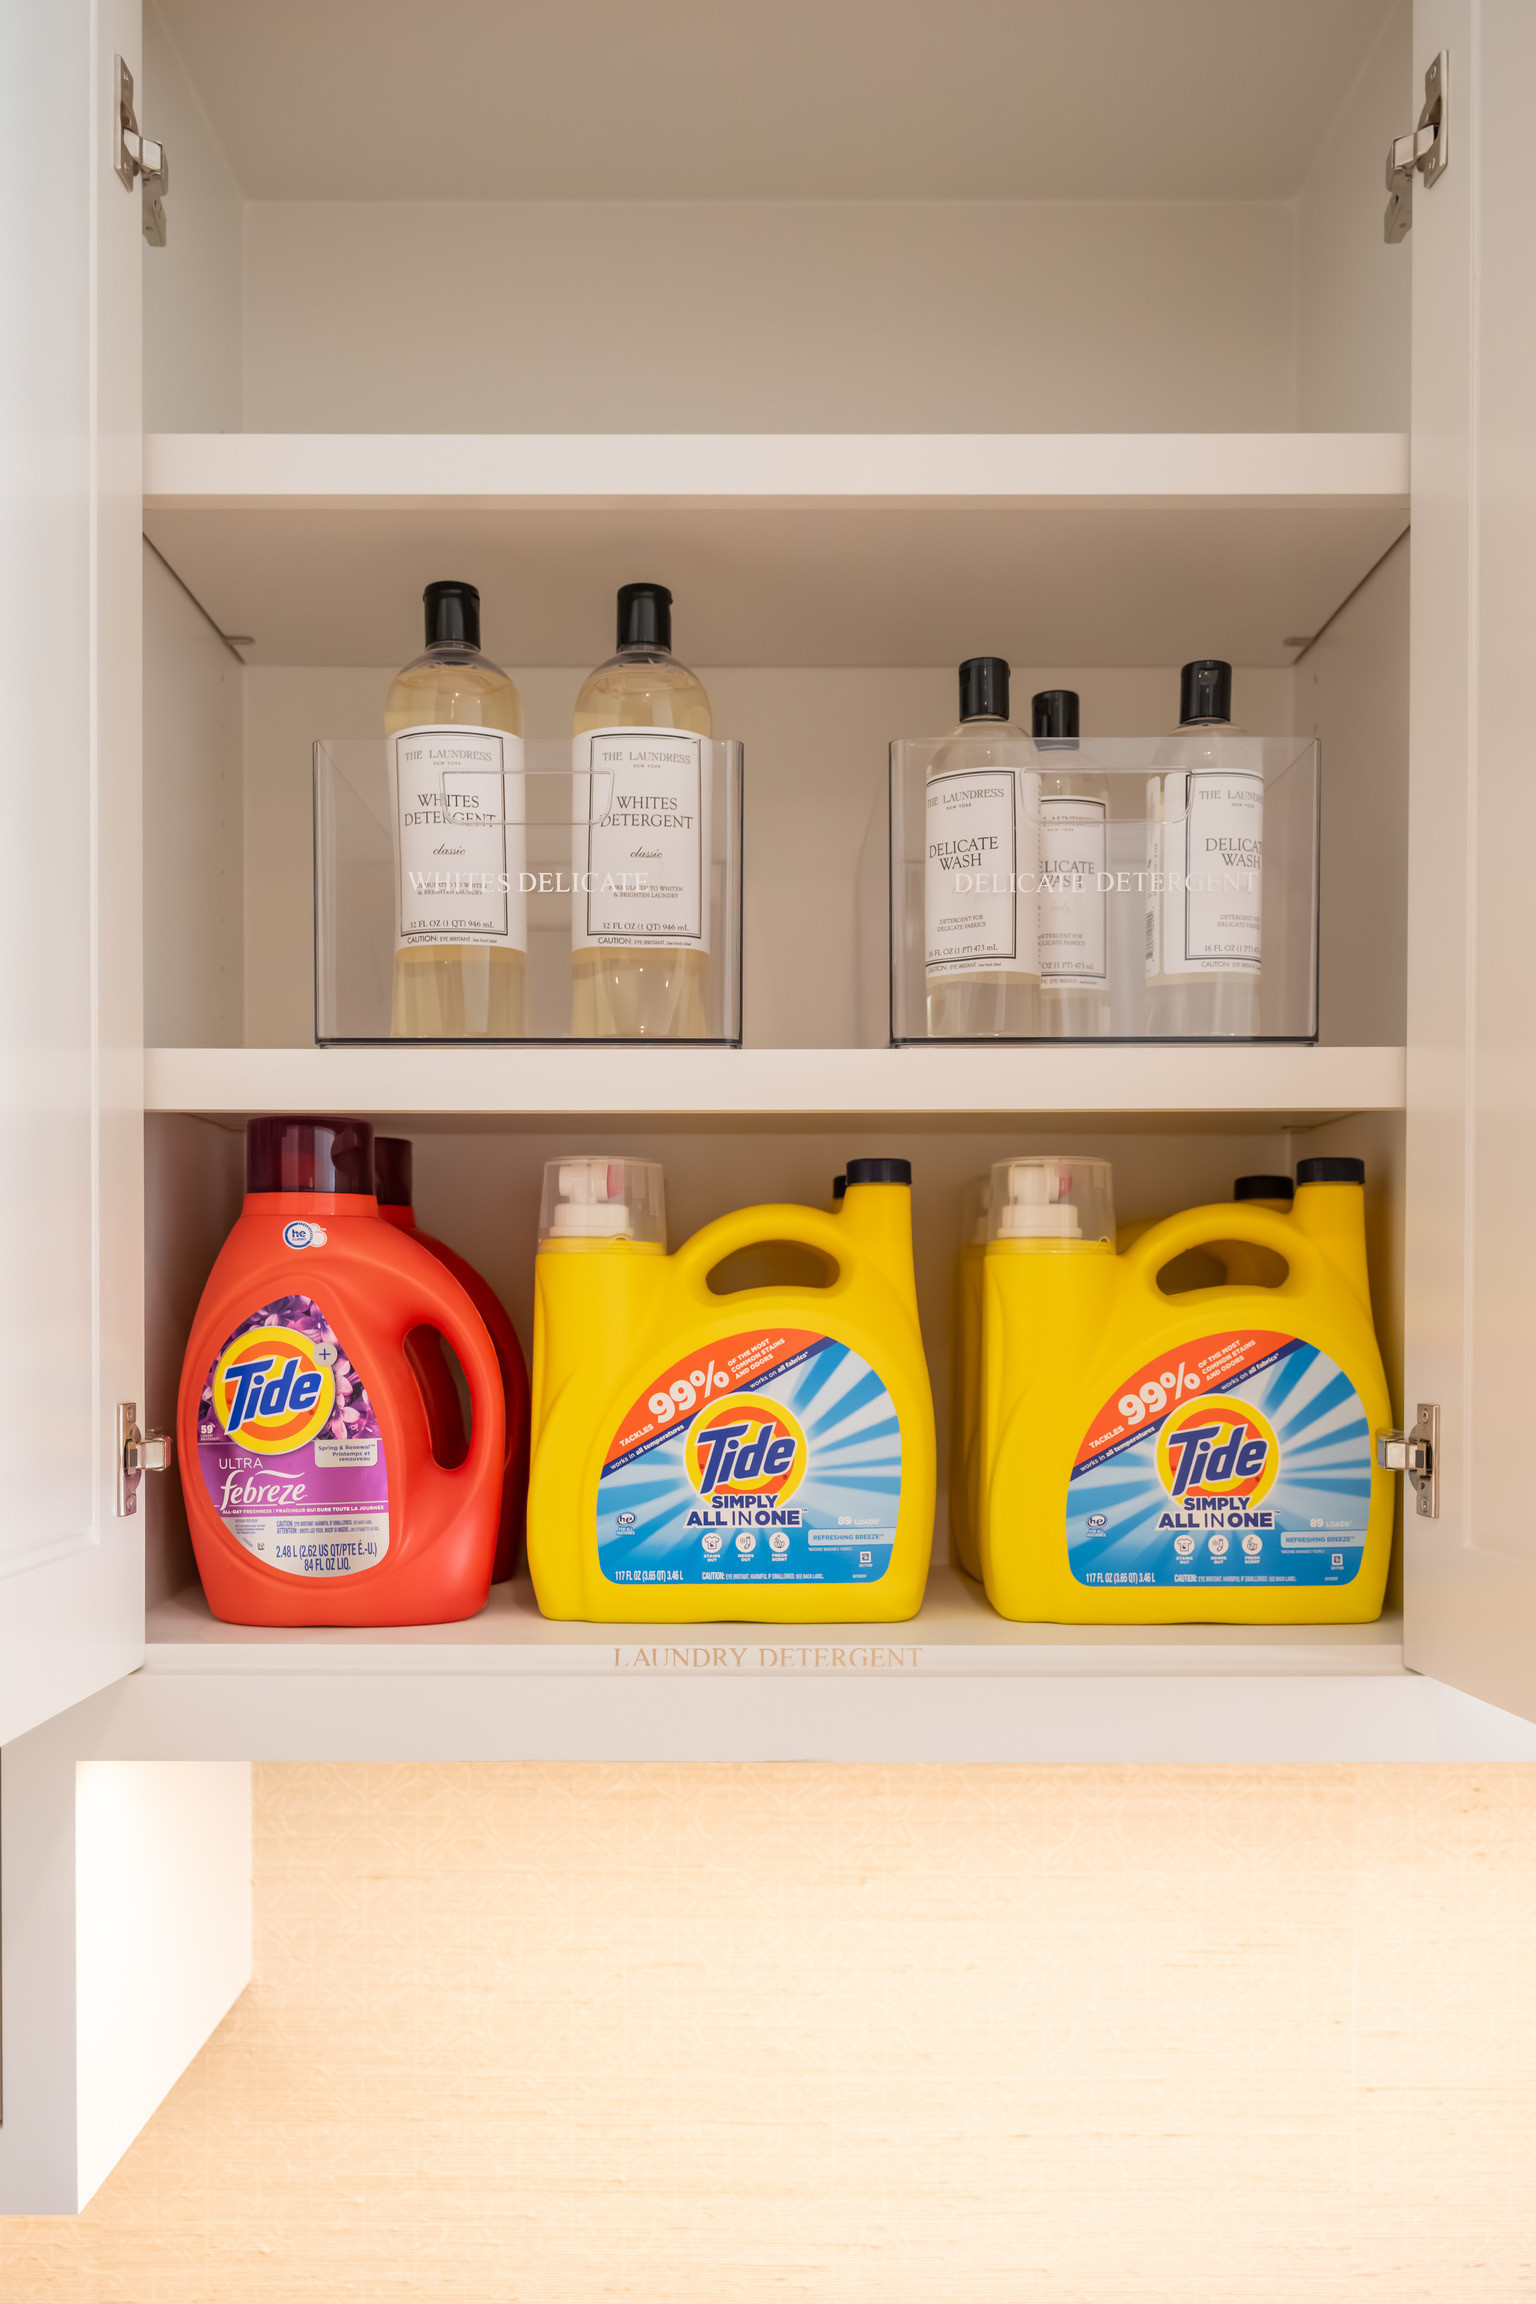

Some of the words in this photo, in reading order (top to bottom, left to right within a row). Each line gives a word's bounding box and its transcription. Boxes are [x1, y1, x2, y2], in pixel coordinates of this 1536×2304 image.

[405, 751, 423, 761] THE
[429, 750, 492, 761] LAUNDRESS
[603, 752, 623, 761] THE
[629, 751, 691, 764] LAUNDRESS
[417, 793, 480, 809] WHITES
[616, 795, 678, 810] WHITES
[943, 788, 1005, 804] LAUNDRESS
[1199, 790, 1222, 800] THE
[600, 814, 693, 829] DETERGENT
[433, 843, 466, 856] classic
[630, 846, 663, 859] classic
[929, 836, 999, 858] DELICATE
[939, 853, 982, 870] WASH
[1040, 860, 1095, 875] ELICATE
[1222, 853, 1260, 869] WASH
[408, 871, 511, 893] WHITES
[518, 872, 649, 893] DELICATE
[955, 872, 1086, 893] DELICATE
[1096, 872, 1259, 892] DETERGENT
[418, 920, 428, 928] FL
[451, 920, 467, 928] QT)
[468, 920, 481, 928] 946
[602, 922, 611, 930] 32
[637, 923, 644, 931] (1
[646, 923, 661, 931] QT)
[662, 923, 676, 931] 946
[937, 924, 963, 932] DELICATE
[964, 921, 987, 929] FABRICS
[940, 915, 971, 925] DETERGENT
[407, 935, 438, 944] CAUTION:
[598, 937, 633, 945] CAUTION:
[934, 949, 942, 957] FL
[954, 947, 960, 955] (1
[962, 946, 973, 955] PT)
[974, 944, 985, 952] 473
[1224, 944, 1236, 952] OZ
[292, 1229, 306, 1238] he
[727, 1357, 737, 1367] OF
[737, 1349, 752, 1361] THE
[750, 1338, 770, 1353] MOST
[731, 1352, 761, 1373] COMMON
[760, 1338, 786, 1355] STAINS
[1198, 1359, 1208, 1369] OF
[1208, 1351, 1222, 1362] THE
[1221, 1339, 1240, 1354] MOST
[1202, 1354, 1232, 1375] COMMON
[1231, 1339, 1256, 1357] STAINS
[735, 1368, 750, 1380] AND
[750, 1353, 774, 1370] ODORS
[1206, 1369, 1221, 1381] AND
[1221, 1355, 1245, 1372] ODORS
[750, 1375, 769, 1389] works
[768, 1370, 778, 1378] on
[777, 1364, 786, 1373] all
[1221, 1377, 1240, 1391] works
[1240, 1372, 1249, 1380] on
[1248, 1366, 1257, 1375] all
[223, 1356, 324, 1434] Tide
[619, 1423, 655, 1447] TACKLES
[648, 1360, 730, 1424] 99%
[1089, 1425, 1125, 1449] TACKLES
[1117, 1361, 1201, 1425] 99%
[200, 1425, 214, 1434] 59
[610, 1457, 629, 1470] works
[628, 1451, 636, 1459] in
[635, 1446, 644, 1456] all
[643, 1424, 685, 1452] temperatures
[1080, 1459, 1099, 1472] works
[1099, 1454, 1106, 1462] in
[1106, 1448, 1114, 1458] all
[1114, 1426, 1155, 1452] temperatures
[219, 1457, 263, 1469] ULTRA
[695, 1422, 798, 1495] Tide
[1166, 1423, 1270, 1497] Tide
[220, 1469, 306, 1511] febreze
[711, 1495, 779, 1509] SIMPLY
[1183, 1497, 1250, 1511] SIMPLY
[686, 1511, 727, 1526] ALL
[732, 1511, 752, 1526] IN
[838, 1516, 852, 1525] 89
[1159, 1513, 1200, 1528] ALL
[1204, 1513, 1224, 1528] IN
[1310, 1518, 1324, 1528] 89
[276, 1545, 292, 1558] 2.48
[293, 1545, 298, 1557] L
[299, 1544, 317, 1560] (2.62
[318, 1544, 329, 1557] US
[330, 1542, 356, 1557] QT/PTE
[358, 1540, 378, 1557] É.-U.)
[304, 1558, 313, 1571] 84
[315, 1558, 324, 1571] FL
[326, 1558, 336, 1571] OZ
[337, 1557, 351, 1571] LIQ.
[615, 1570, 625, 1580] 117
[626, 1570, 633, 1580] FL
[634, 1570, 641, 1580] OZ
[642, 1570, 656, 1582] (3.65
[657, 1570, 666, 1582] QT)
[667, 1570, 679, 1580] 3.46
[680, 1570, 684, 1580] L
[702, 1572, 725, 1580] CAUTION:
[1086, 1573, 1096, 1583] 117
[1097, 1573, 1104, 1583] FL
[1105, 1573, 1112, 1583] OZ
[1113, 1573, 1127, 1585] (3.65
[1128, 1573, 1138, 1585] QT)
[1139, 1573, 1151, 1583] 3.46
[1152, 1573, 1156, 1583] L
[613, 1647, 748, 1668] LAUNDRY
[759, 1647, 924, 1668] DETERGENT
